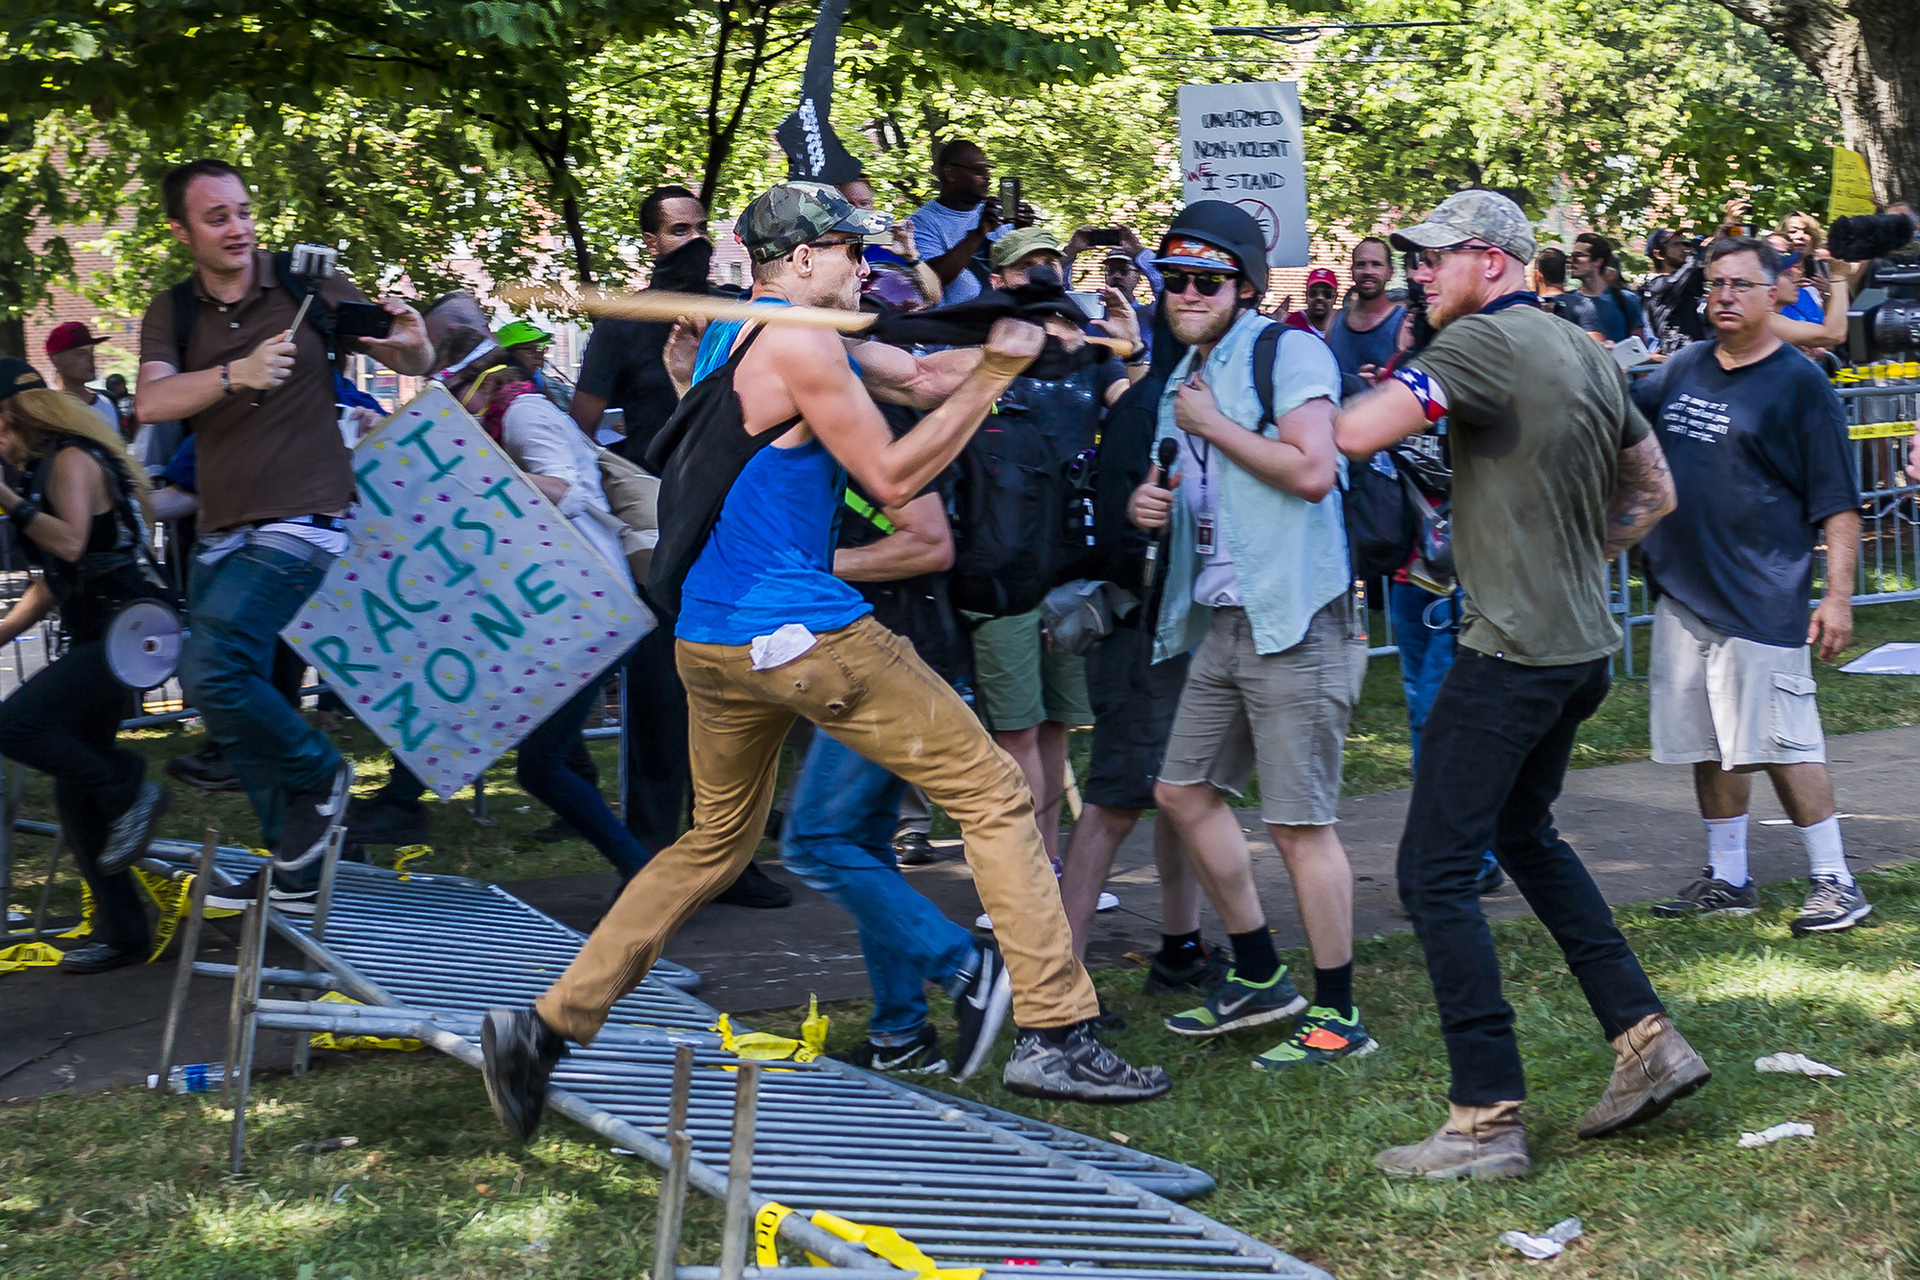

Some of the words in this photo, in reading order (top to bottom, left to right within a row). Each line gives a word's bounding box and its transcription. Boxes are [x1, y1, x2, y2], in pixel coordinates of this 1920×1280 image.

[1202, 109, 1283, 129] UNARMED
[1224, 172, 1286, 191] STAND
[310, 477, 525, 687] RACIST
[371, 562, 567, 752] ZONE
